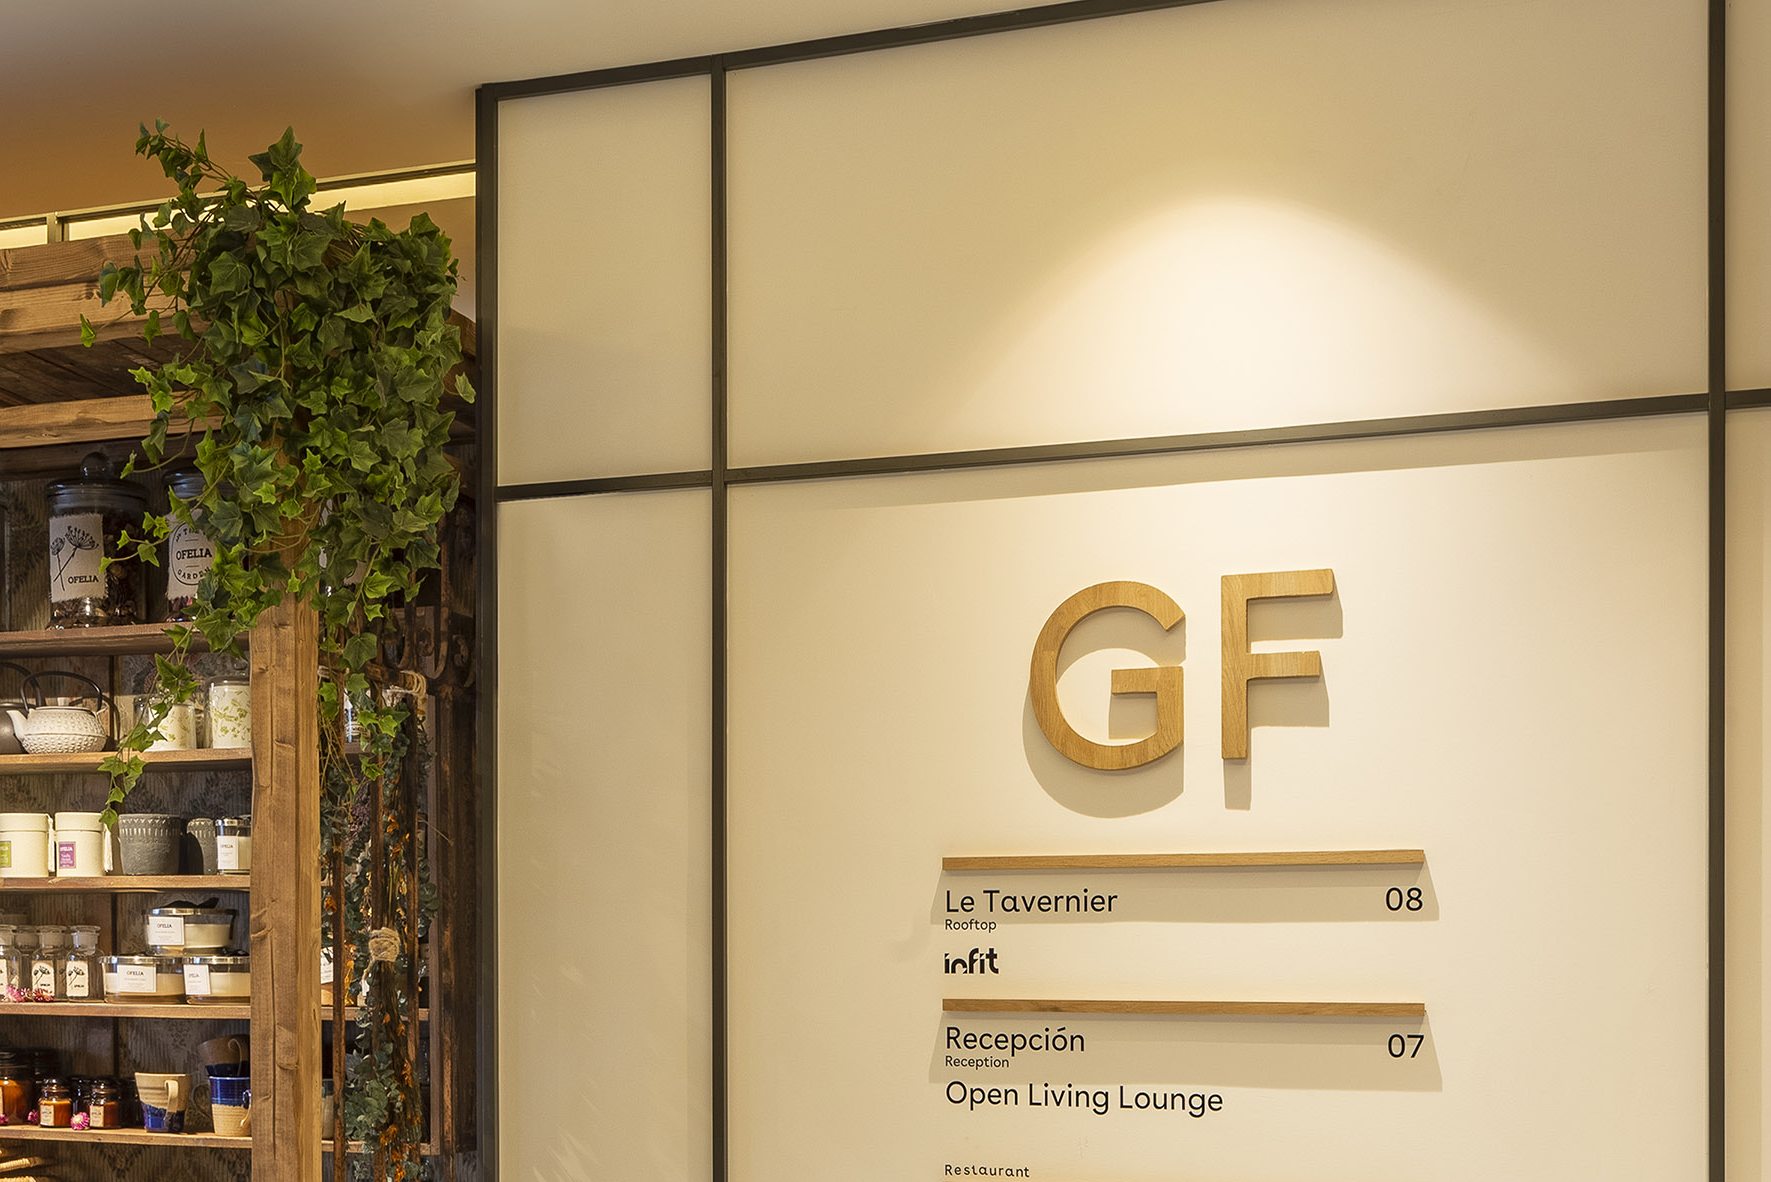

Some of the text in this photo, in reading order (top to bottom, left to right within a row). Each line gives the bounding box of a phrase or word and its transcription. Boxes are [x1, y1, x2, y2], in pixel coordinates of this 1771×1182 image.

[176, 548, 213, 561] OFELIA
[67, 575, 99, 584] OFELIA
[1029, 568, 1334, 771] GF
[946, 888, 1118, 913] Le Tavernier
[1385, 887, 1423, 912] 08
[944, 918, 997, 934] Rooftop
[946, 1026, 1085, 1057] Recepción
[1388, 1033, 1425, 1059] 07
[945, 1055, 1010, 1071] Reception
[946, 1080, 1223, 1118] Open Living Lounge
[944, 1164, 1030, 1178] Restaurant
